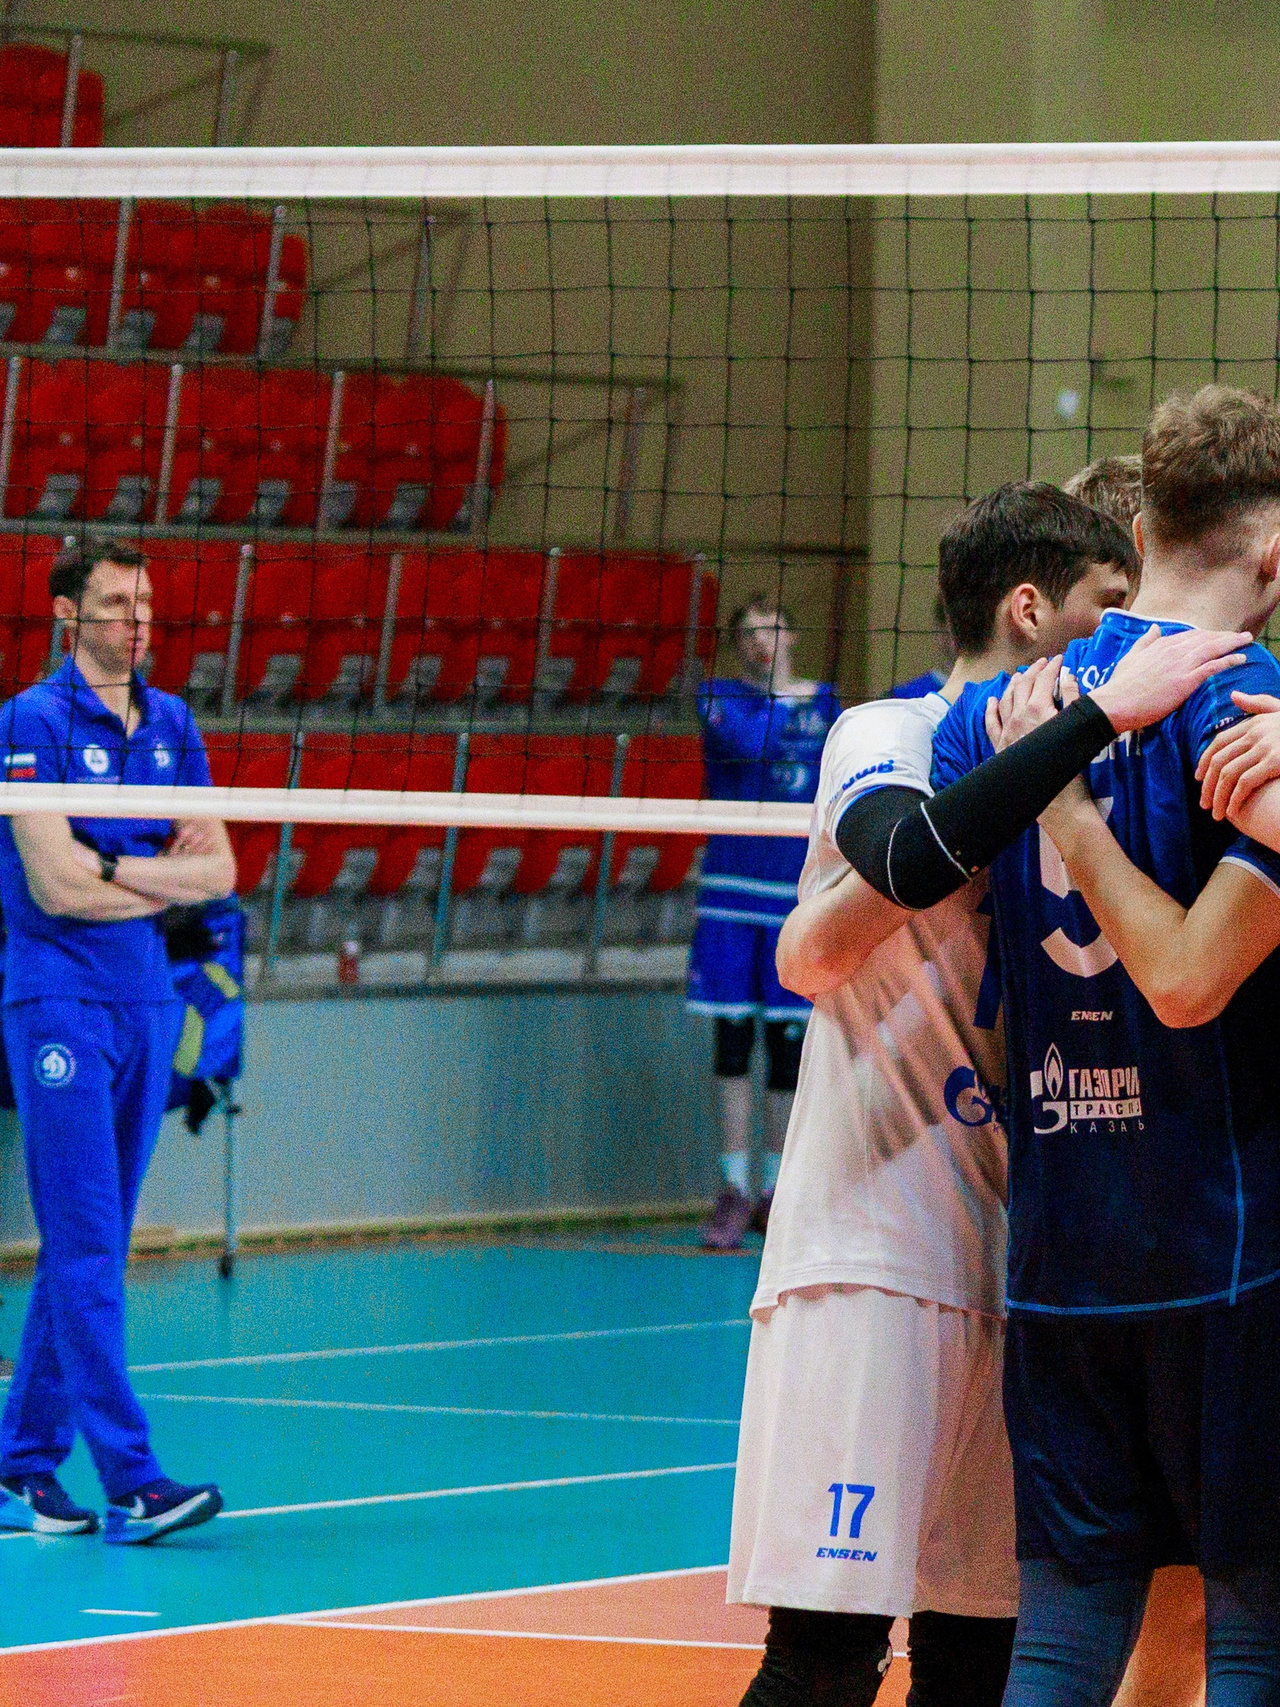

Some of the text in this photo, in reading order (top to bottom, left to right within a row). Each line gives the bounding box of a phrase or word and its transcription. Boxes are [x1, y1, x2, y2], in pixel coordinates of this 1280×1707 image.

[1070, 1120, 1145, 1134] КАЗАЬ
[828, 1482, 876, 1539] 17
[816, 1547, 878, 1562] ENSEN
